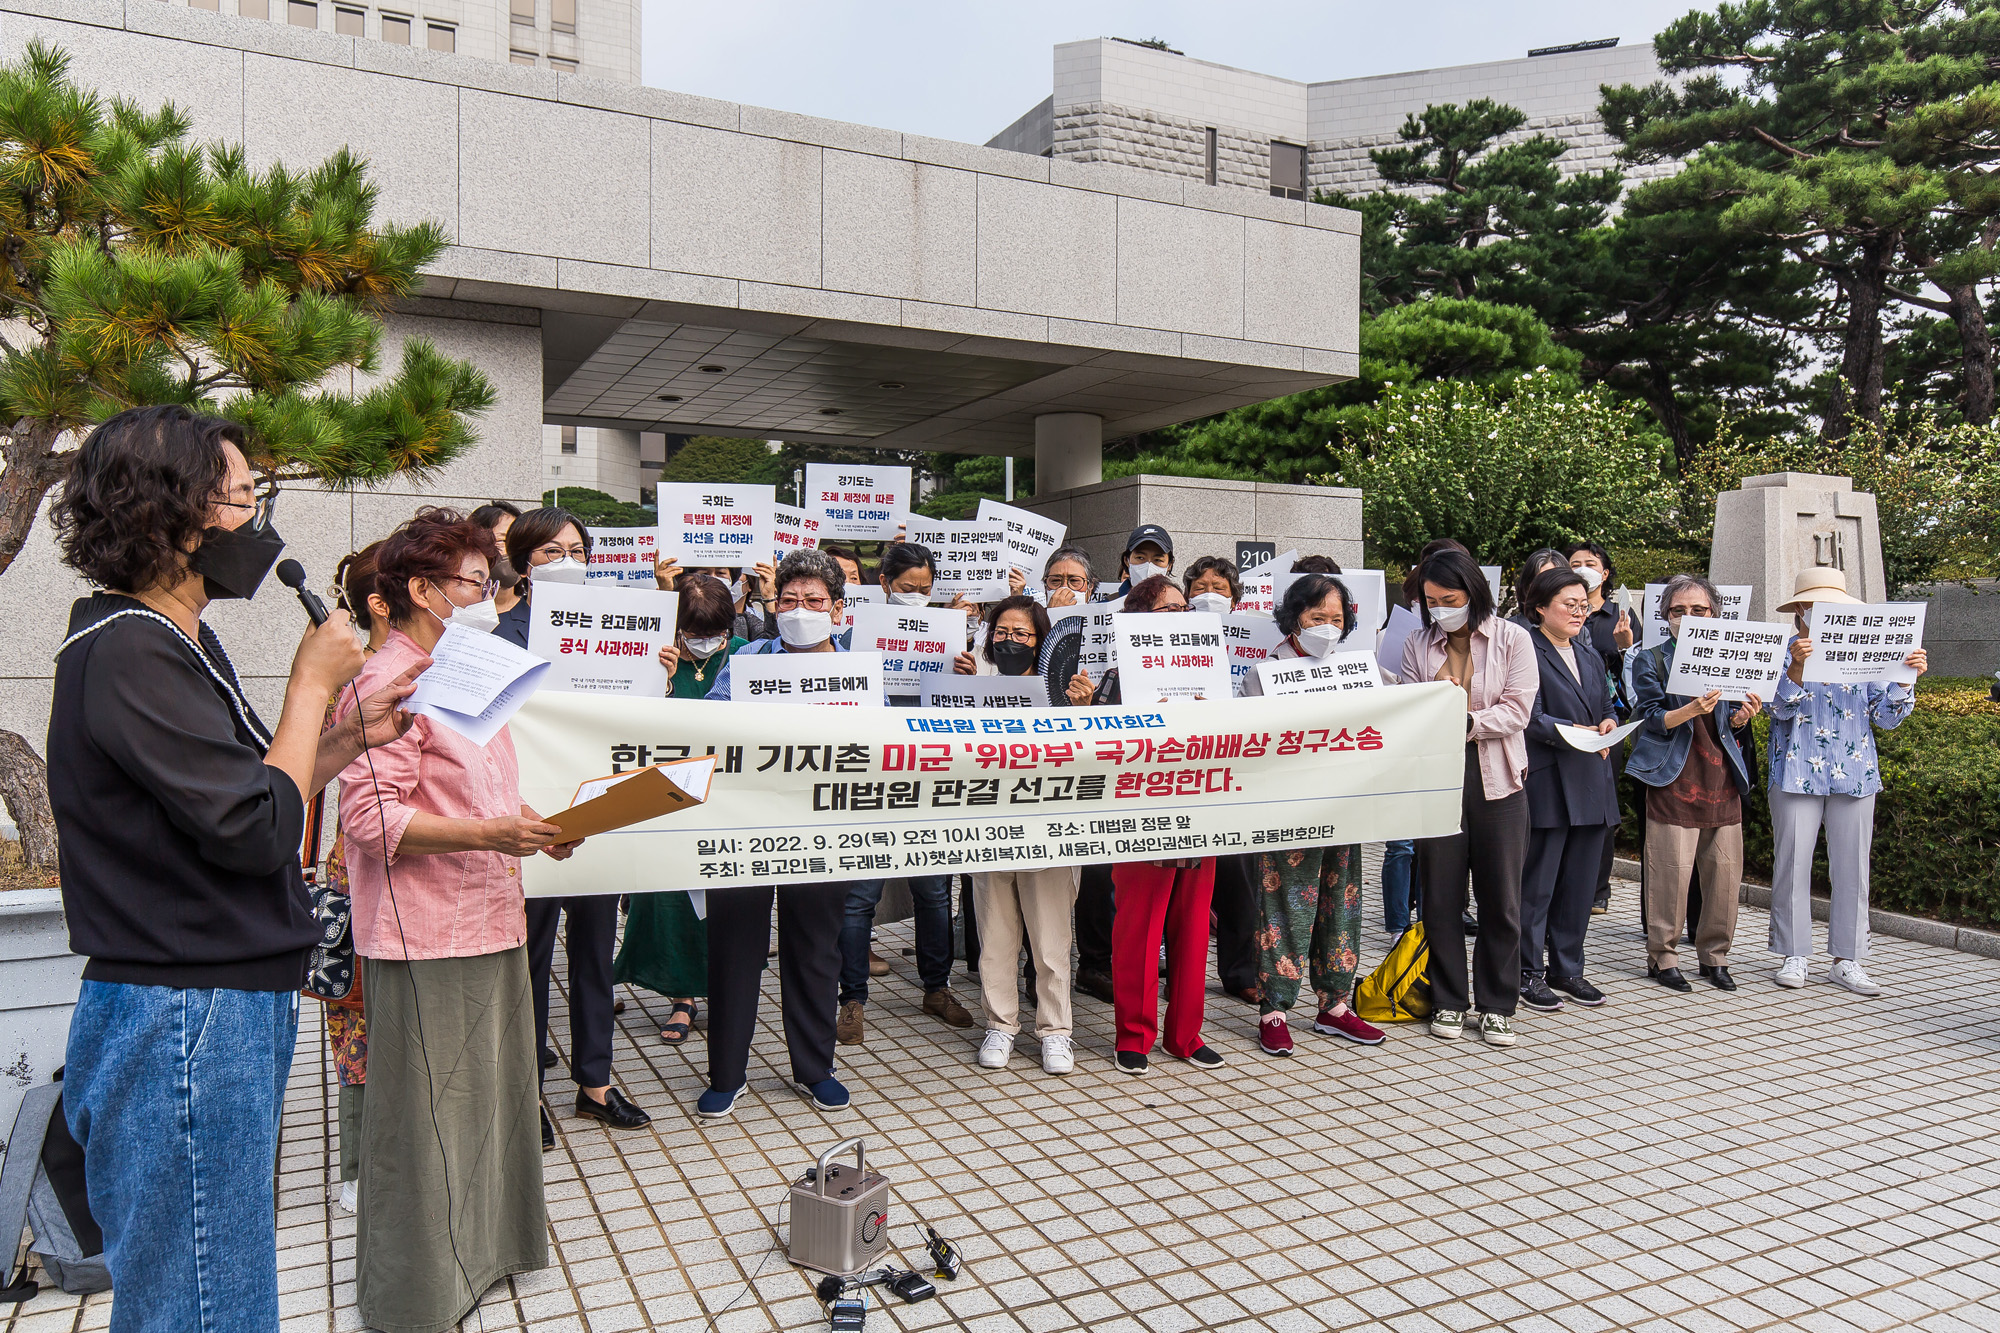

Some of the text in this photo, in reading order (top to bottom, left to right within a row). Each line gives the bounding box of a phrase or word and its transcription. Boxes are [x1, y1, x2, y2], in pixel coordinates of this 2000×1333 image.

[838, 476, 874, 487] 경기도는
[702, 495, 734, 507] 국회는
[821, 491, 895, 504] 조례 제정에 따른
[683, 513, 752, 526] 특별법 제정에
[825, 508, 890, 520] 책임을 다하라!
[774, 512, 801, 527] 정하여
[803, 519, 819, 531] 주한
[599, 536, 634, 547] 개정하여
[638, 535, 654, 546] 주한
[683, 532, 753, 544] 최선을 다하라!
[802, 537, 816, 548] 위한
[914, 532, 1004, 544] 기지촌 미군위안부에
[1027, 527, 1055, 546] 사법부는
[641, 552, 655, 562] 위한
[948, 551, 977, 563] 국가의
[981, 550, 998, 562] 책임
[627, 570, 656, 580] 신설하라
[967, 568, 993, 581] 인정한
[996, 568, 1007, 580] 날!
[1260, 585, 1272, 595] 주한
[550, 610, 661, 632] 정부는 원고들에게
[1720, 612, 1739, 620] 결을
[1823, 614, 1916, 627] 기지촌 미군 위안부
[897, 618, 929, 633] 국회는
[1130, 633, 1220, 648] 정부는 원고들에게
[1687, 627, 1783, 646] 기지촌 미군위안부에
[1820, 632, 1914, 645] 관련 대법원 판결을
[560, 638, 648, 656] 공식 사과하라!
[876, 637, 946, 654] 특별법 제정에
[1234, 646, 1267, 660] 제정에
[1692, 646, 1773, 663] 대한 국가의 책임
[1825, 650, 1904, 662] 열렬히 환영한다!
[908, 660, 944, 673] 다하라!
[1142, 655, 1214, 669] 공식 사과하라!
[1272, 662, 1369, 685] 기지촌 미군 위안부
[1679, 663, 1778, 681] 공식적으로 인정한 날!
[749, 679, 792, 695] 정부는
[800, 676, 868, 693] 원고들에게
[931, 694, 1032, 708] 대한민국 사법부는
[906, 713, 1166, 734] 대법원 판결 선고 기자회견
[756, 743, 871, 773] 기지촌
[882, 743, 953, 772] 미군
[1095, 732, 1272, 765] 국가손해배상
[1276, 725, 1384, 755] 청구소송
[813, 767, 1243, 811] 대법원 판결 선고를 환영한다.
[697, 815, 1191, 855] 일시: 2022. 9. 29(목) 오전 10시 30분 장소: 대법원 정문 앞
[699, 825, 1335, 879] 주최: 원고인들, 두레방, 사)햇살사회복지회, 새움터, 여성인권센터 쉬고, 공동변호인단
